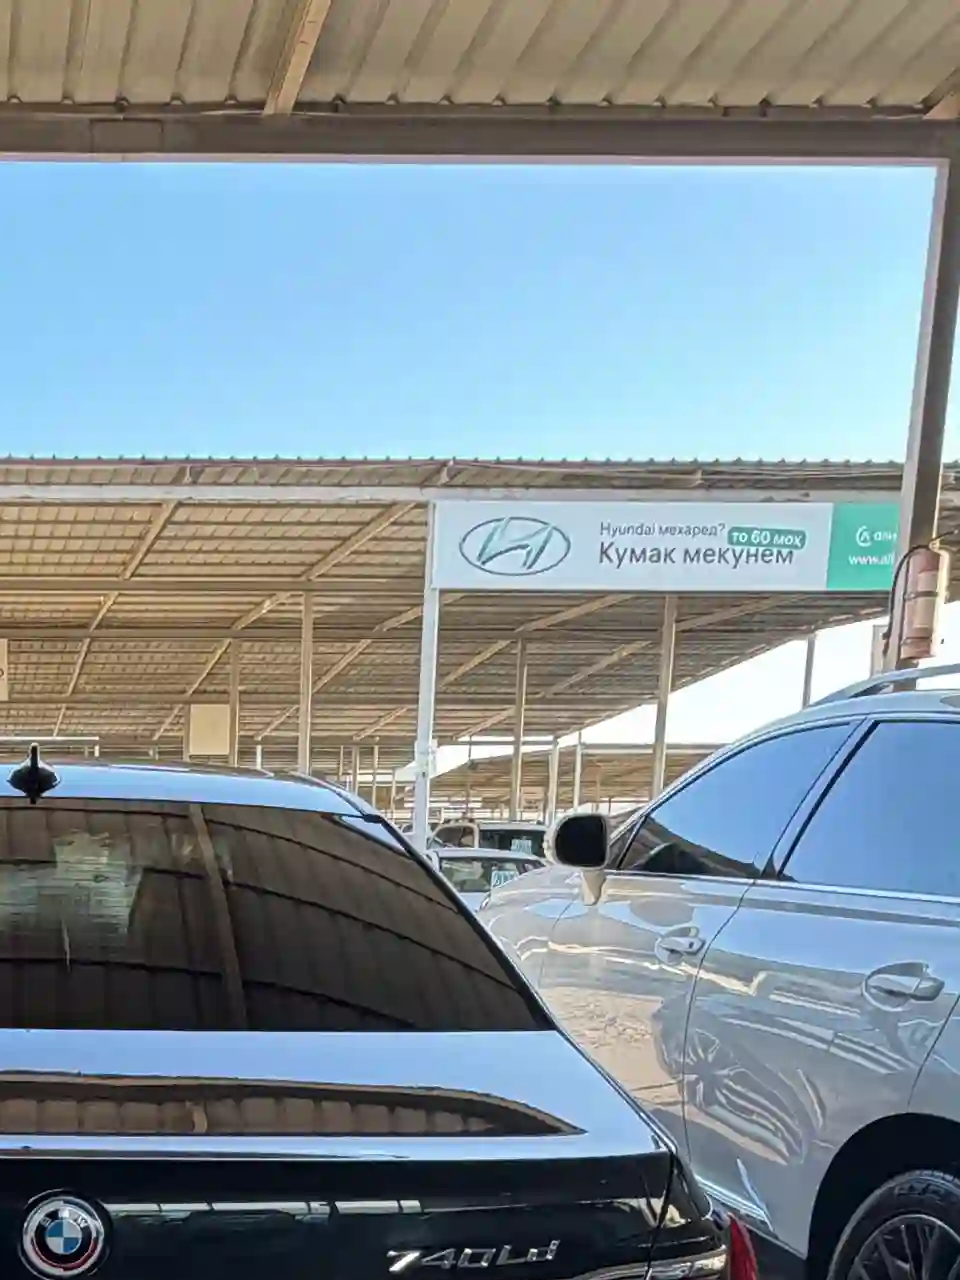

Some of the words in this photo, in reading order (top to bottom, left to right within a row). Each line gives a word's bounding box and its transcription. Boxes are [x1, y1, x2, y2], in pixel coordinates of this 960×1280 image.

[600, 521, 656, 538] Hyundai
[751, 529, 771, 544] 60
[599, 541, 677, 569] Кумак
[683, 547, 795, 569] мекунем
[386, 1239, 561, 1274] 740Ld
